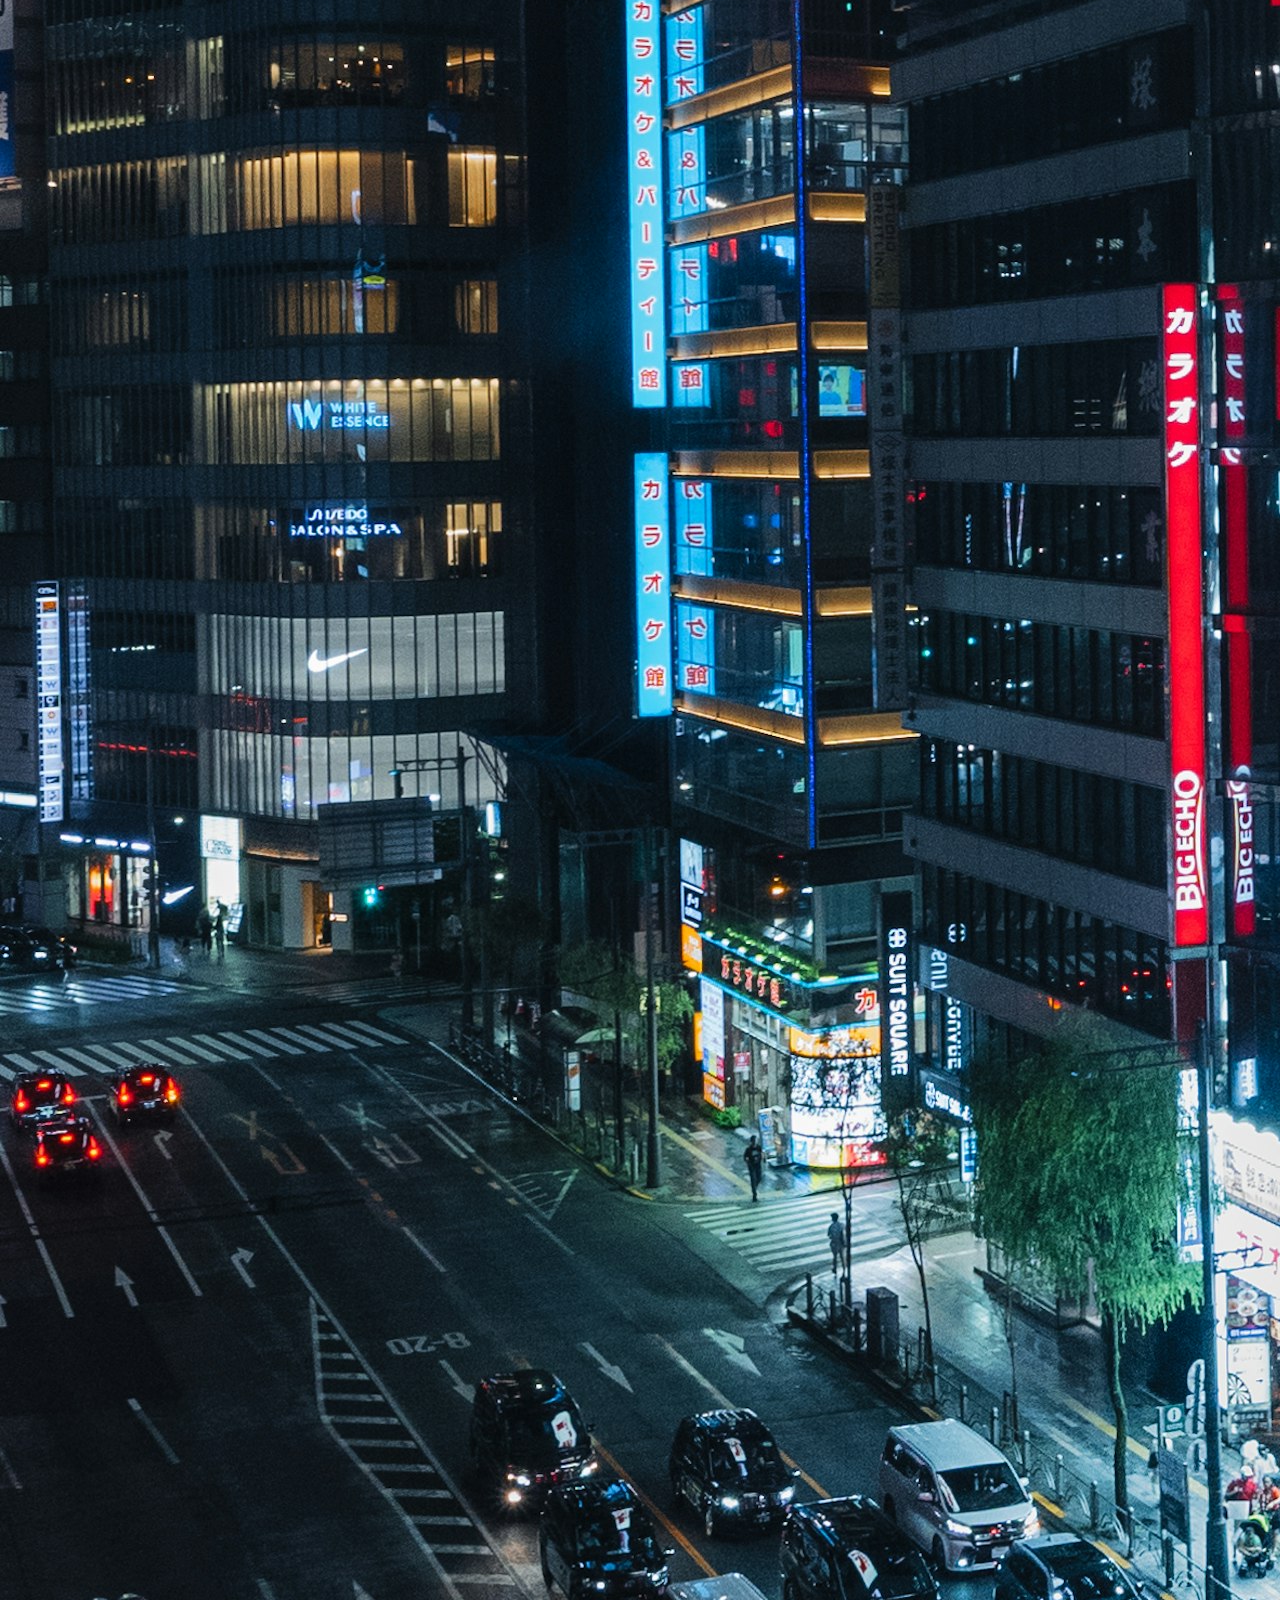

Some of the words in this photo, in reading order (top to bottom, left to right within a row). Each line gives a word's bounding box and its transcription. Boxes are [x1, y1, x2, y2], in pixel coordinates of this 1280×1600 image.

[329, 402, 377, 414] WHITE
[331, 415, 389, 428] ESSENCE
[1166, 307, 1197, 468] カラオケ
[643, 479, 664, 688] カラオケ館
[1173, 770, 1200, 852] ECHO
[1175, 855, 1204, 911] BIG
[889, 953, 908, 994] SUIT
[888, 997, 909, 1078] SQUARE
